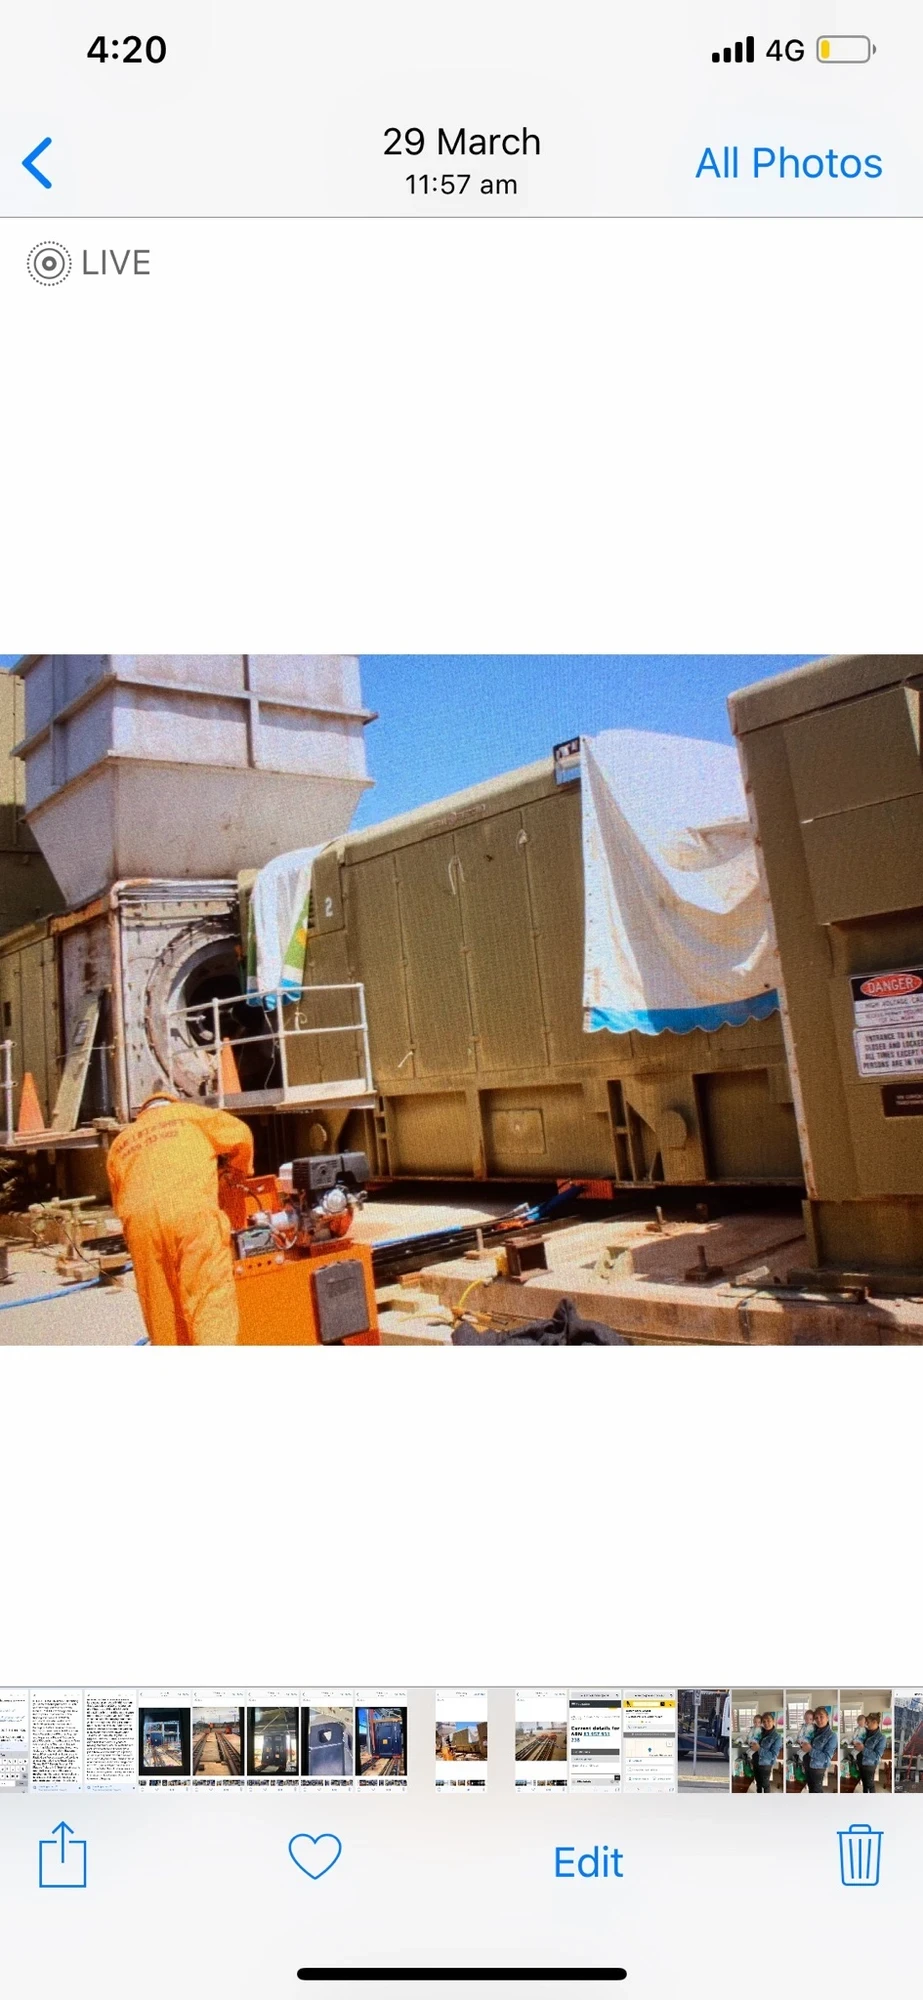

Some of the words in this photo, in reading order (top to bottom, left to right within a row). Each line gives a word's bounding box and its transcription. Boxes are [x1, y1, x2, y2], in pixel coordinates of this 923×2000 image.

[325, 897, 333, 917] 2
[868, 977, 914, 993] DANGER
[865, 1032, 895, 1042] ENTRANCE
[888, 1041, 901, 1049] AND
[863, 1060, 889, 1069] PERSONS
